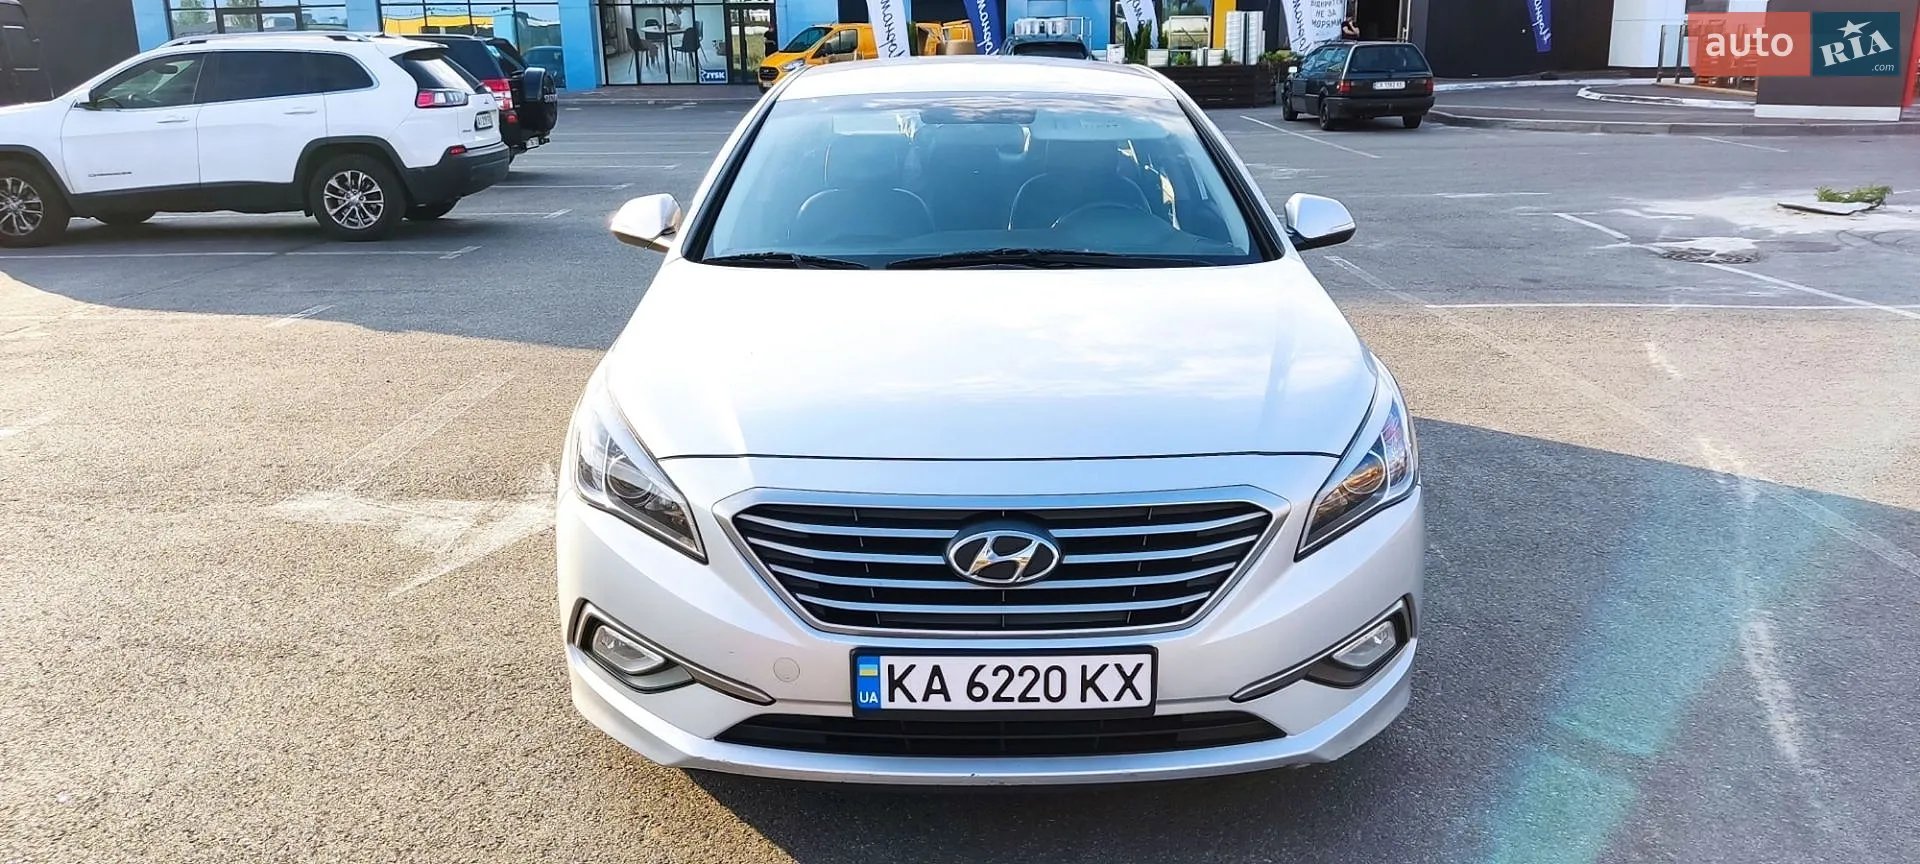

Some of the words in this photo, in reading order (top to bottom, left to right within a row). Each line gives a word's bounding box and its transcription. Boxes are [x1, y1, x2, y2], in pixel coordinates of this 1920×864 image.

[1315, 9, 1324, 18] НЕ
[706, 71, 725, 79] JYSK
[887, 664, 952, 703] KA
[966, 664, 1067, 703] 6220
[1080, 662, 1144, 703] KX
[859, 692, 879, 704] UA
